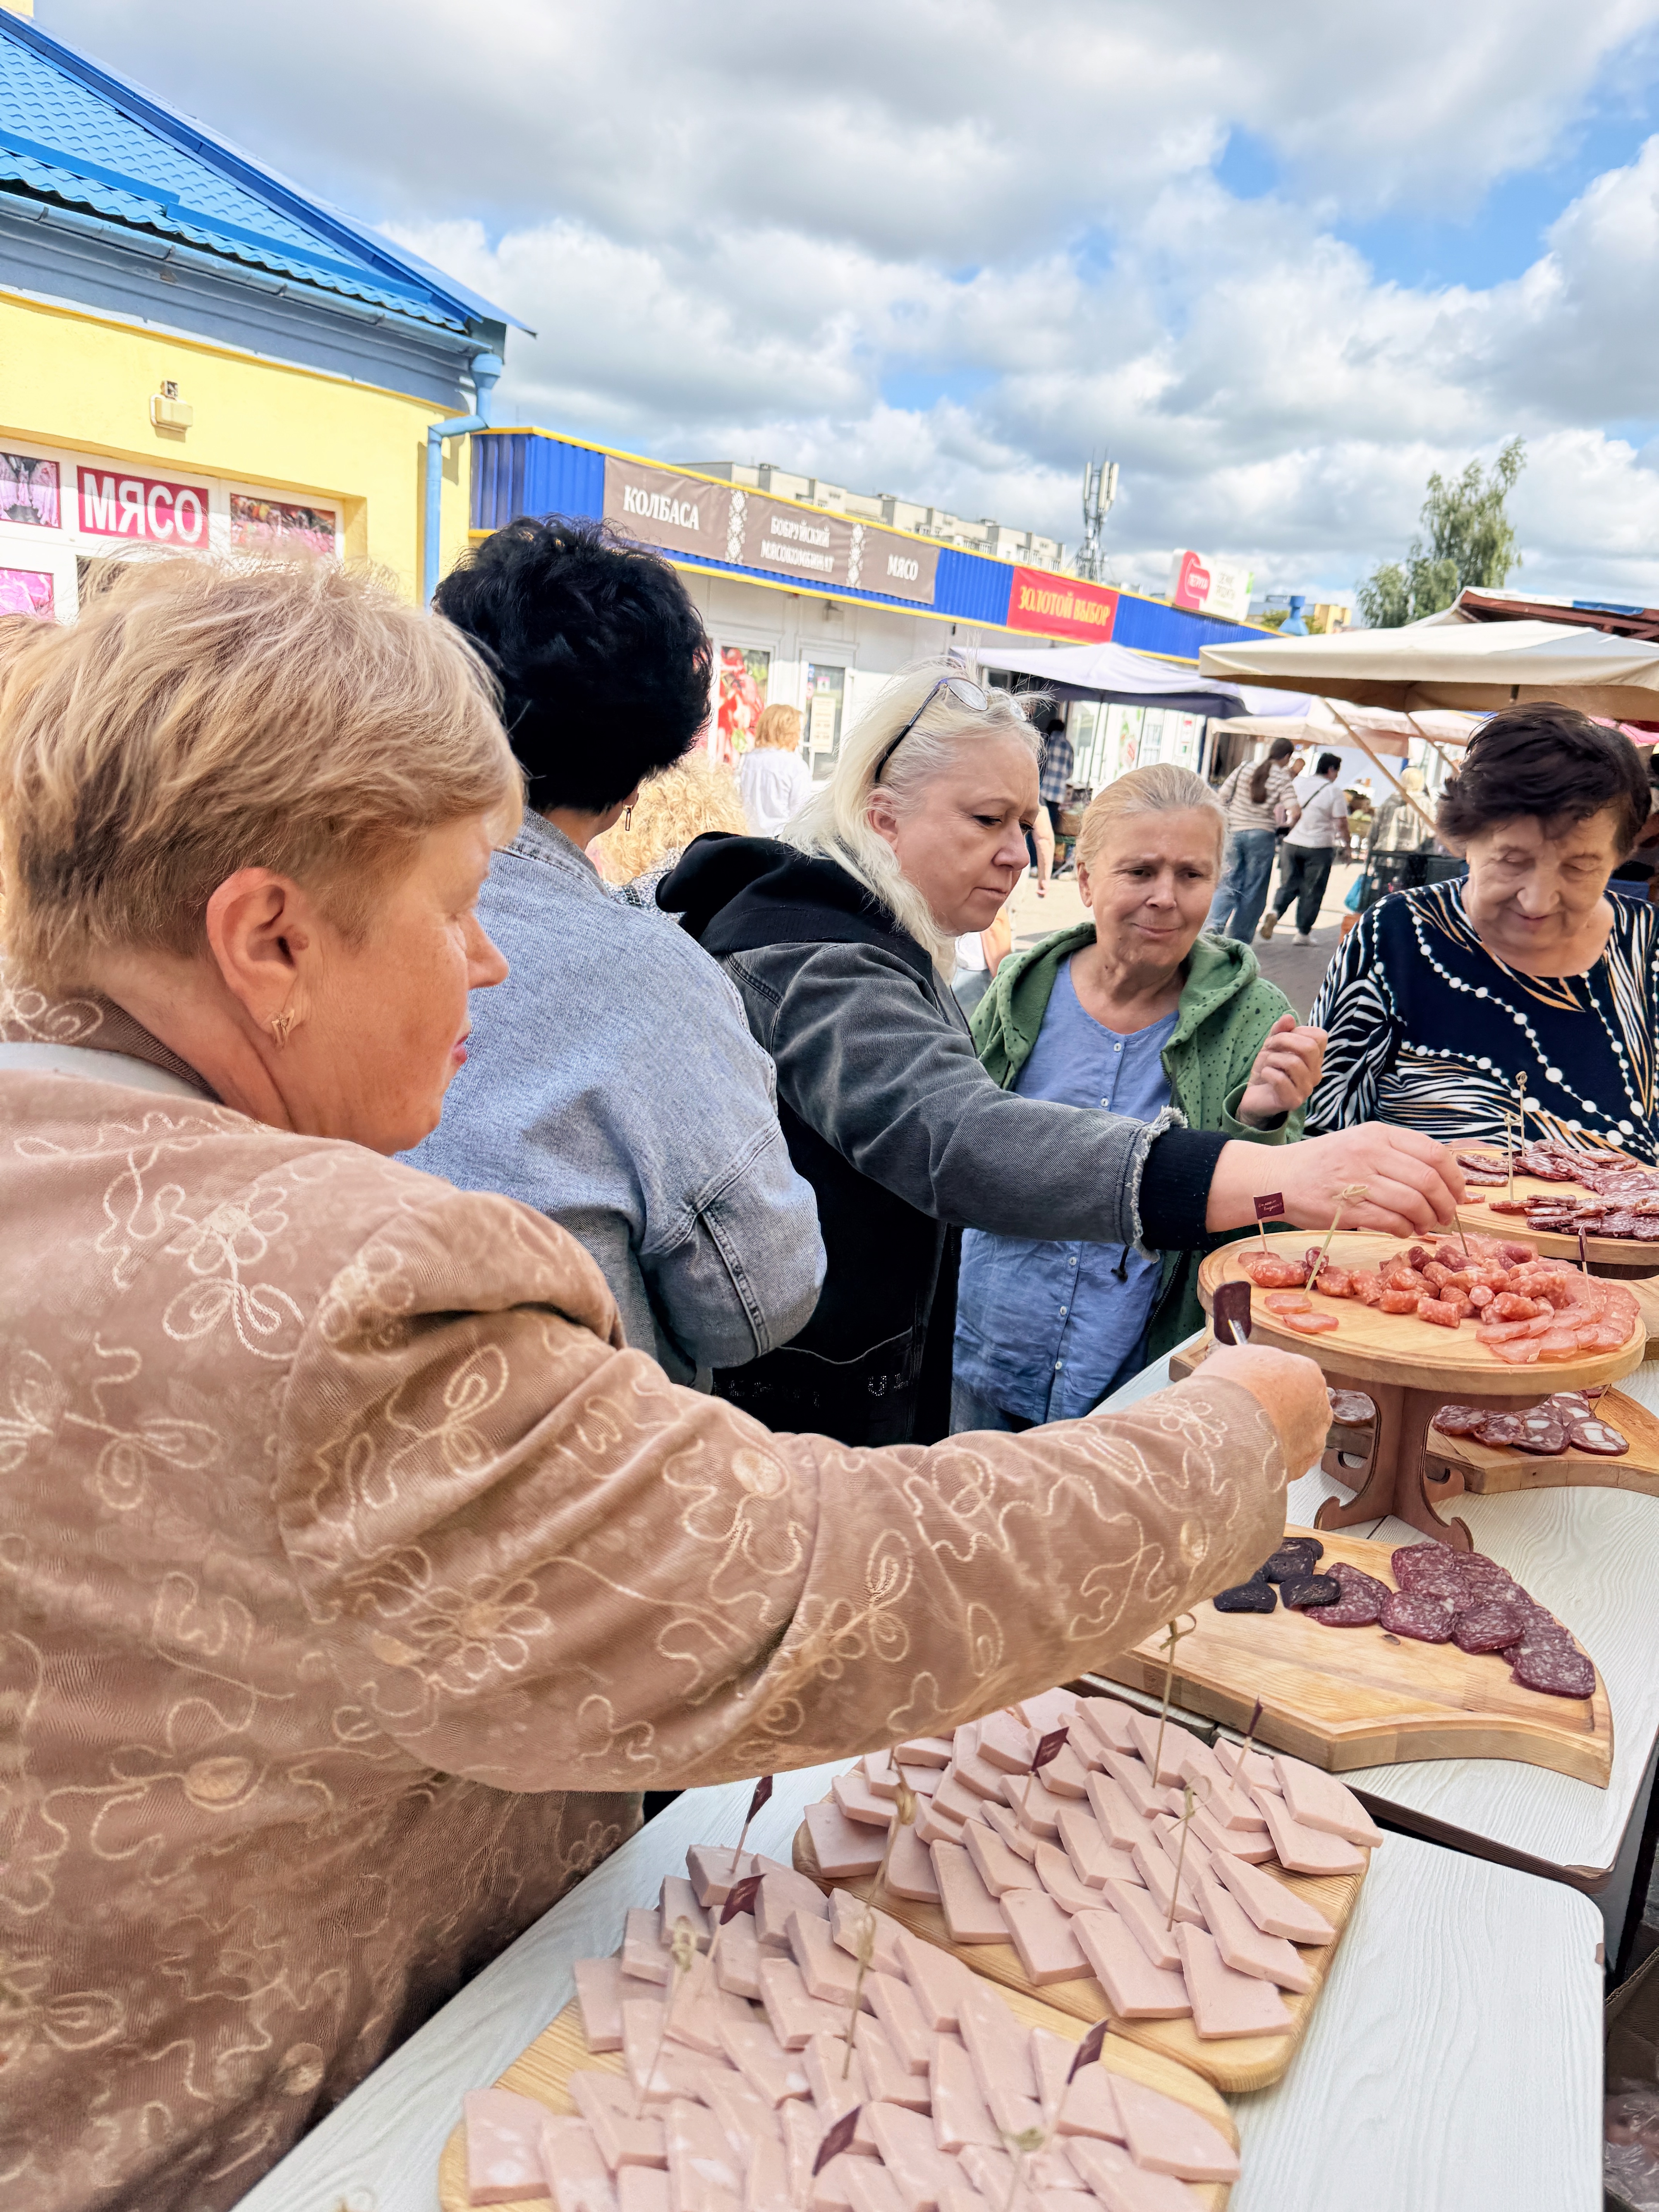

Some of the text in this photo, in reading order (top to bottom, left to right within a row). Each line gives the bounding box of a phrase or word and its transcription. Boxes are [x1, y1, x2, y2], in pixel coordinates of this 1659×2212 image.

[84, 473, 203, 543] МЯСО
[623, 484, 700, 531] КОЛБАСА
[770, 515, 830, 548] БОБРУЙСКИЙ
[760, 539, 835, 573] МЯСОКОМБИНАТ
[887, 554, 919, 581] МЯСО
[1018, 585, 1111, 627] ЗОЛОТОЙ ВЫБОР
